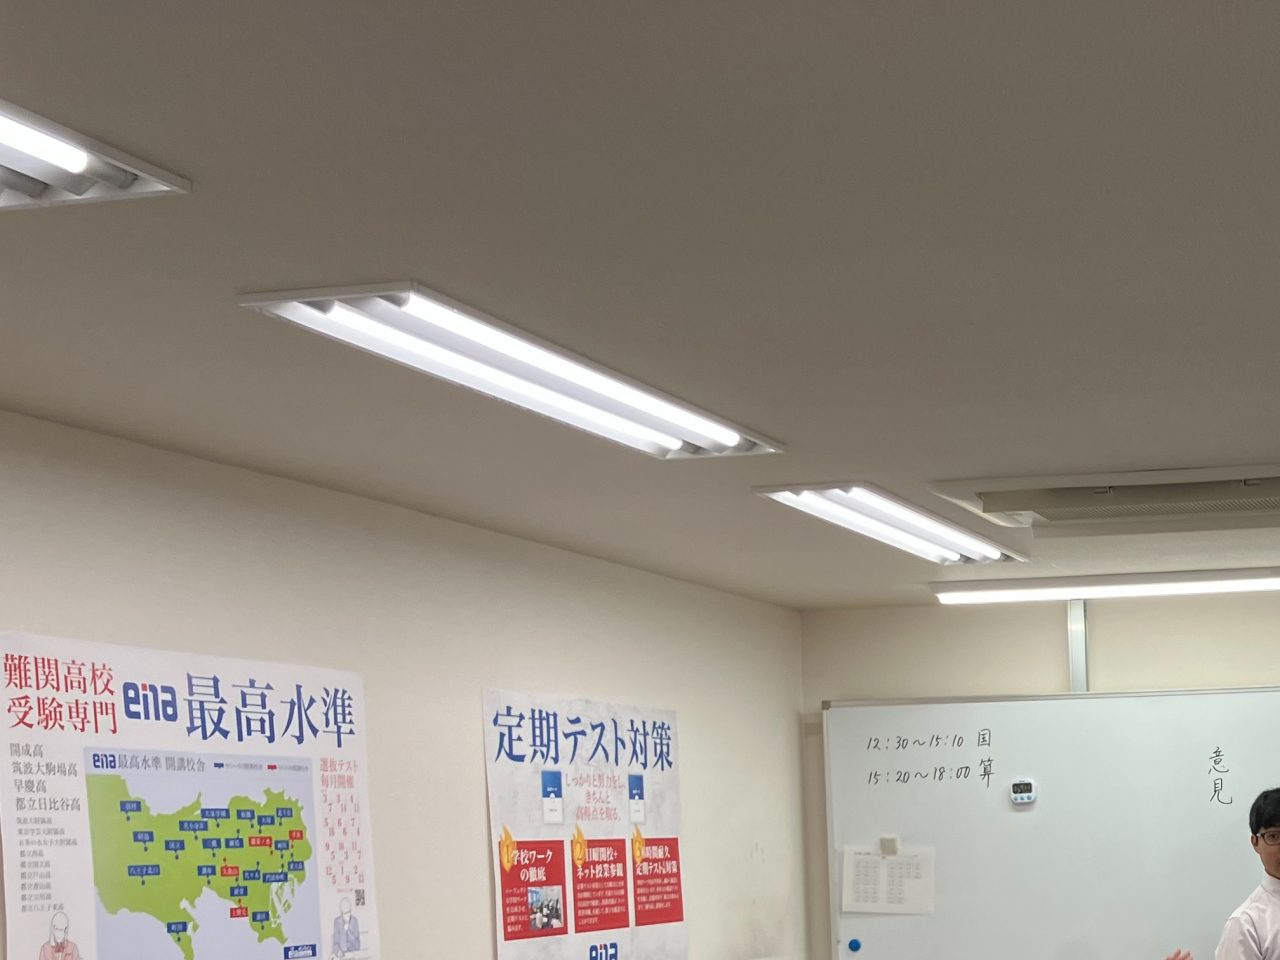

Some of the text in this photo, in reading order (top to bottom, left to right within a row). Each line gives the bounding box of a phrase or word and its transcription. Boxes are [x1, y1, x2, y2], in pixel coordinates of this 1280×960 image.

[3, 653, 114, 696] 難関高校
[7, 695, 118, 735] 受験専門
[183, 672, 355, 748] 最高水準
[492, 705, 673, 772] 定期テスト対策
[977, 728, 991, 748] 国
[9, 742, 43, 758] 開成高
[118, 753, 162, 771] 最高水準
[320, 757, 358, 773] 選抜テスト
[979, 757, 996, 789] 算
[1208, 747, 1233, 806] 意見
[14, 779, 47, 793] 早慶高
[16, 797, 81, 812] 都立日比谷高
[511, 848, 553, 867] 学校ワーク
